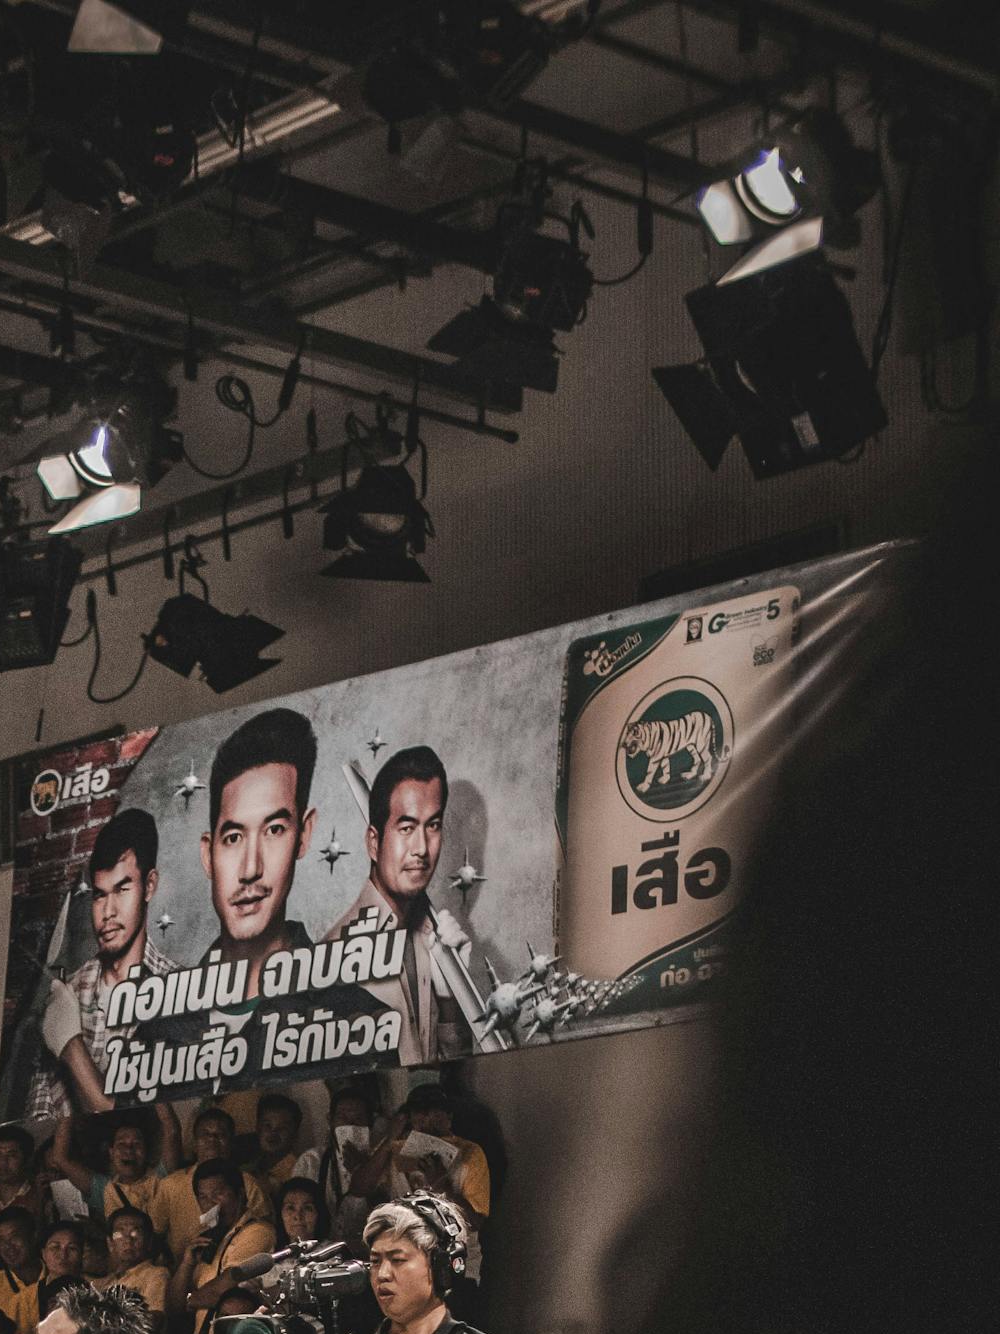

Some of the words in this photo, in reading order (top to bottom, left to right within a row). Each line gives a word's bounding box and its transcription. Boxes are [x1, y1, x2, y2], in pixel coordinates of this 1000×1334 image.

[766, 598, 781, 620] 5
[62, 762, 110, 799] เสือ
[611, 829, 731, 915] เสือ
[106, 949, 249, 1028] ก่อแน่น
[263, 906, 407, 998] ฉาบลื่น
[103, 1023, 249, 1102] ใช้ปูนเสือ
[262, 1008, 402, 1070] ไร้กังวล
